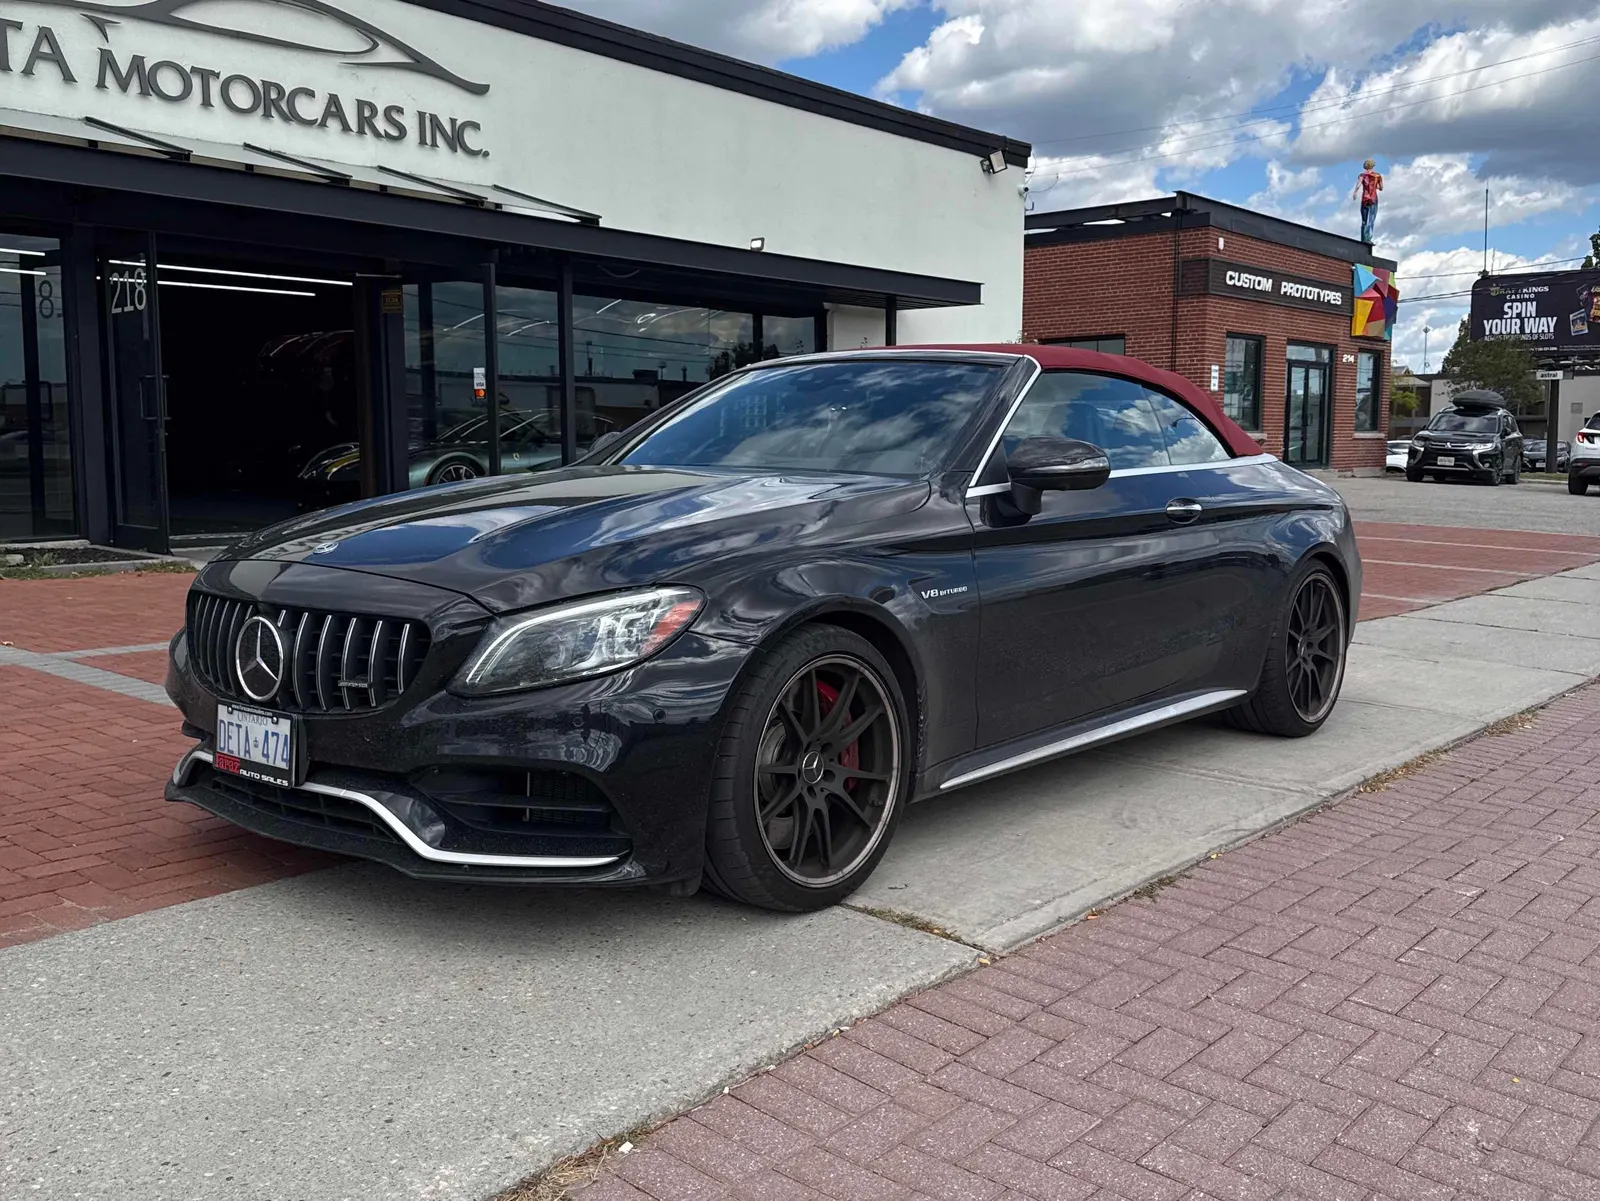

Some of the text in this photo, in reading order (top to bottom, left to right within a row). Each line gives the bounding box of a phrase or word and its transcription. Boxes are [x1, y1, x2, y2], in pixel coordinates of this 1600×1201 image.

[95, 47, 407, 142] MOTORCARS
[417, 110, 490, 158] INC.
[110, 268, 146, 314] 218
[1226, 271, 1342, 305] CUSTOM PROTOTYPES
[1503, 301, 1537, 318] SPIN
[1483, 316, 1557, 335] YOUR WAY
[1539, 332, 1555, 340] SLOTS
[1342, 354, 1355, 364] 214
[921, 586, 968, 599] V8 BITURBO
[237, 711, 269, 726] ONTARIO
[219, 720, 289, 768] DETA 474
[239, 768, 289, 787] AUTO SALES
